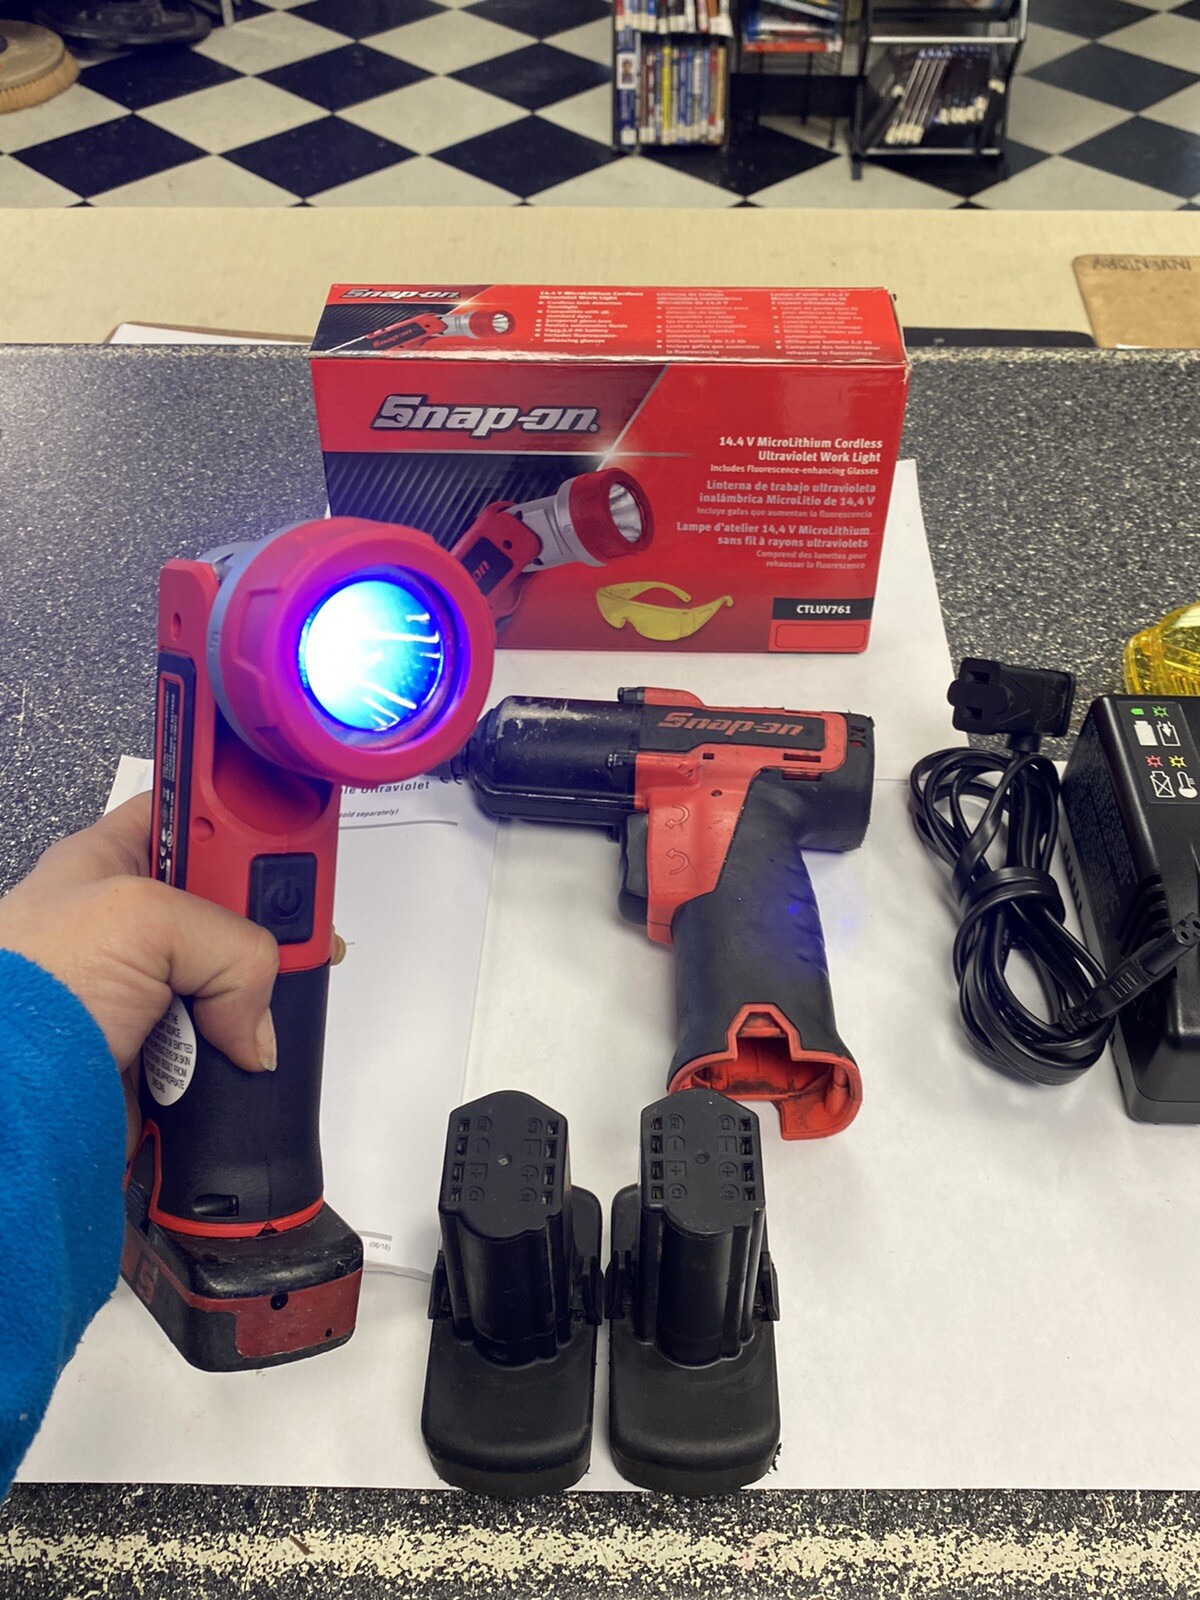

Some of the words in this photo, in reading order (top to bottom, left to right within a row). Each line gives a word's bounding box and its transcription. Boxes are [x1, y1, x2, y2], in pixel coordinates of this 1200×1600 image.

[341, 288, 460, 300] Snap-on
[371, 394, 599, 437] Snap-on
[719, 437, 743, 446] 14.4
[747, 437, 754, 446] V
[757, 437, 831, 448] MicroLithium
[834, 439, 883, 449] Cordless
[758, 451, 817, 462] Ultraviolet
[820, 452, 849, 462] Work
[852, 453, 881, 464] Light
[710, 464, 745, 472] Includes
[747, 465, 845, 476] Fluorescence-enhancing
[847, 467, 879, 475] Glasses
[707, 480, 752, 490] Linterna
[755, 481, 767, 491] de
[770, 482, 809, 494] trabajo
[813, 483, 876, 493] ultravioleta
[700, 493, 763, 504] inalámbrica
[766, 494, 821, 505] MicroLitio
[824, 497, 837, 506] de
[840, 497, 864, 507] 14,4
[867, 497, 875, 506] V
[697, 507, 725, 516] Incluye
[727, 508, 748, 517] gafas
[751, 510, 766, 518] que
[819, 510, 872, 519] fluorescencia
[677, 522, 711, 533] Lampe
[714, 522, 759, 532] d'atelier
[762, 525, 785, 535] 14,4
[788, 525, 796, 534] V
[798, 525, 870, 535] MicroLithium
[718, 537, 742, 545] sans
[745, 536, 756, 545] fil
[759, 536, 764, 546] à
[768, 538, 804, 549] rayons
[807, 538, 869, 548] ultraviolets
[756, 550, 796, 560] Comprend
[814, 552, 846, 560] lunettes
[849, 553, 867, 562] pour
[766, 560, 805, 568] rehausser
[807, 561, 814, 569] la
[816, 561, 866, 570] fluorescence
[797, 604, 851, 614] CTLUV761
[657, 712, 804, 736] Snap-on
